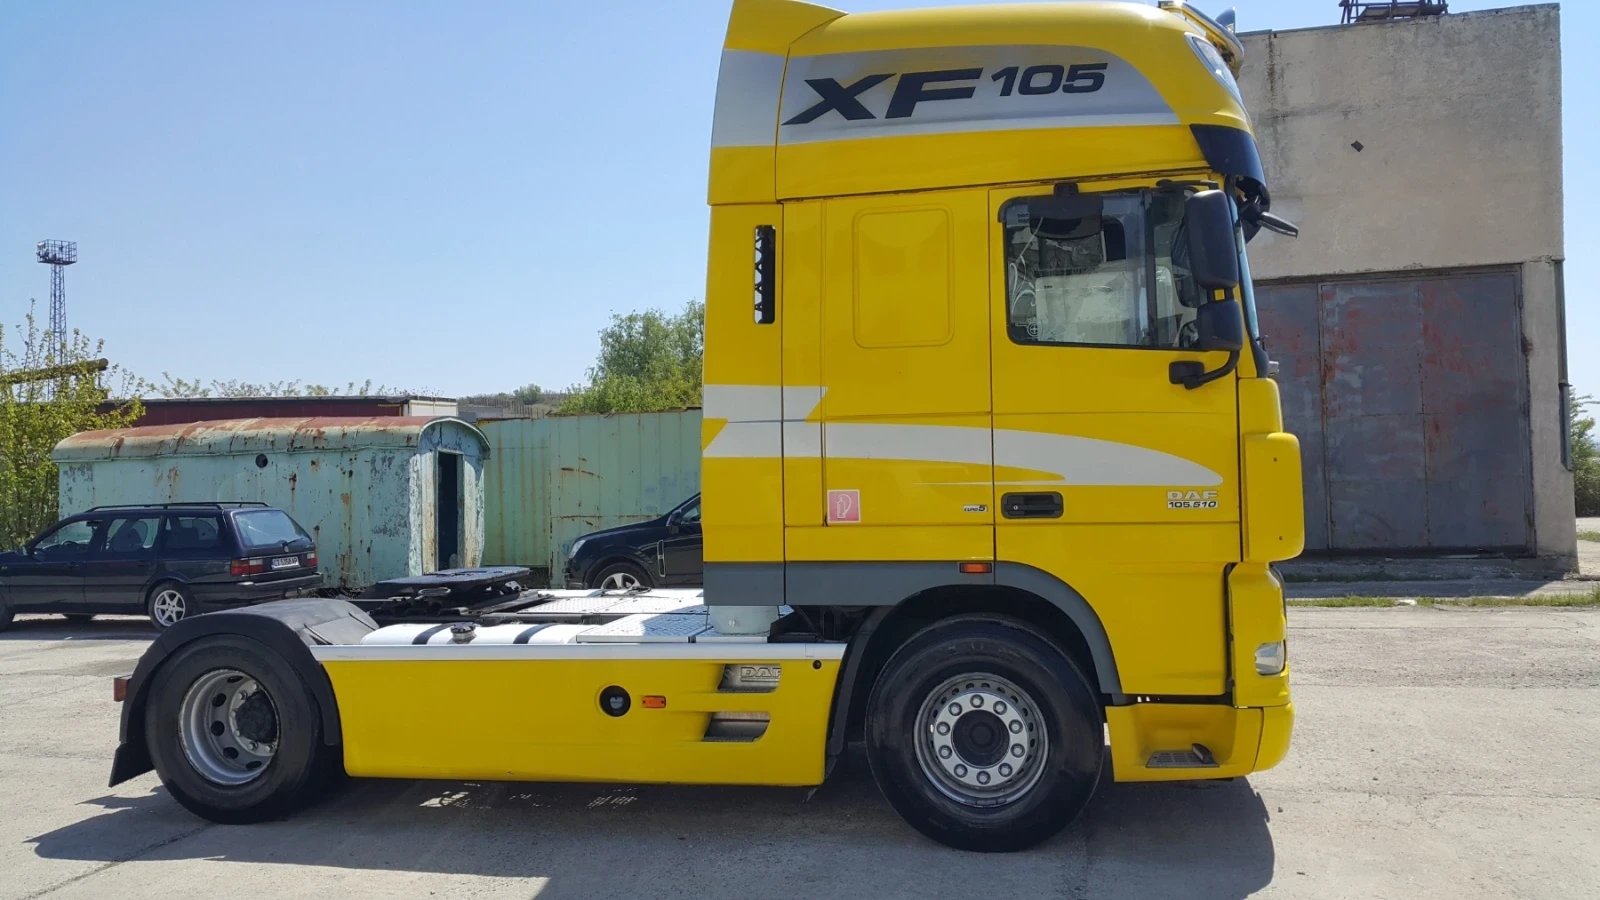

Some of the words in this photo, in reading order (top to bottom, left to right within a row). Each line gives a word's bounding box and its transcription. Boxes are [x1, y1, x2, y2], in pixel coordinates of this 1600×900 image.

[780, 67, 984, 126] XF
[991, 62, 1108, 97] 105
[1167, 490, 1218, 500] DAF
